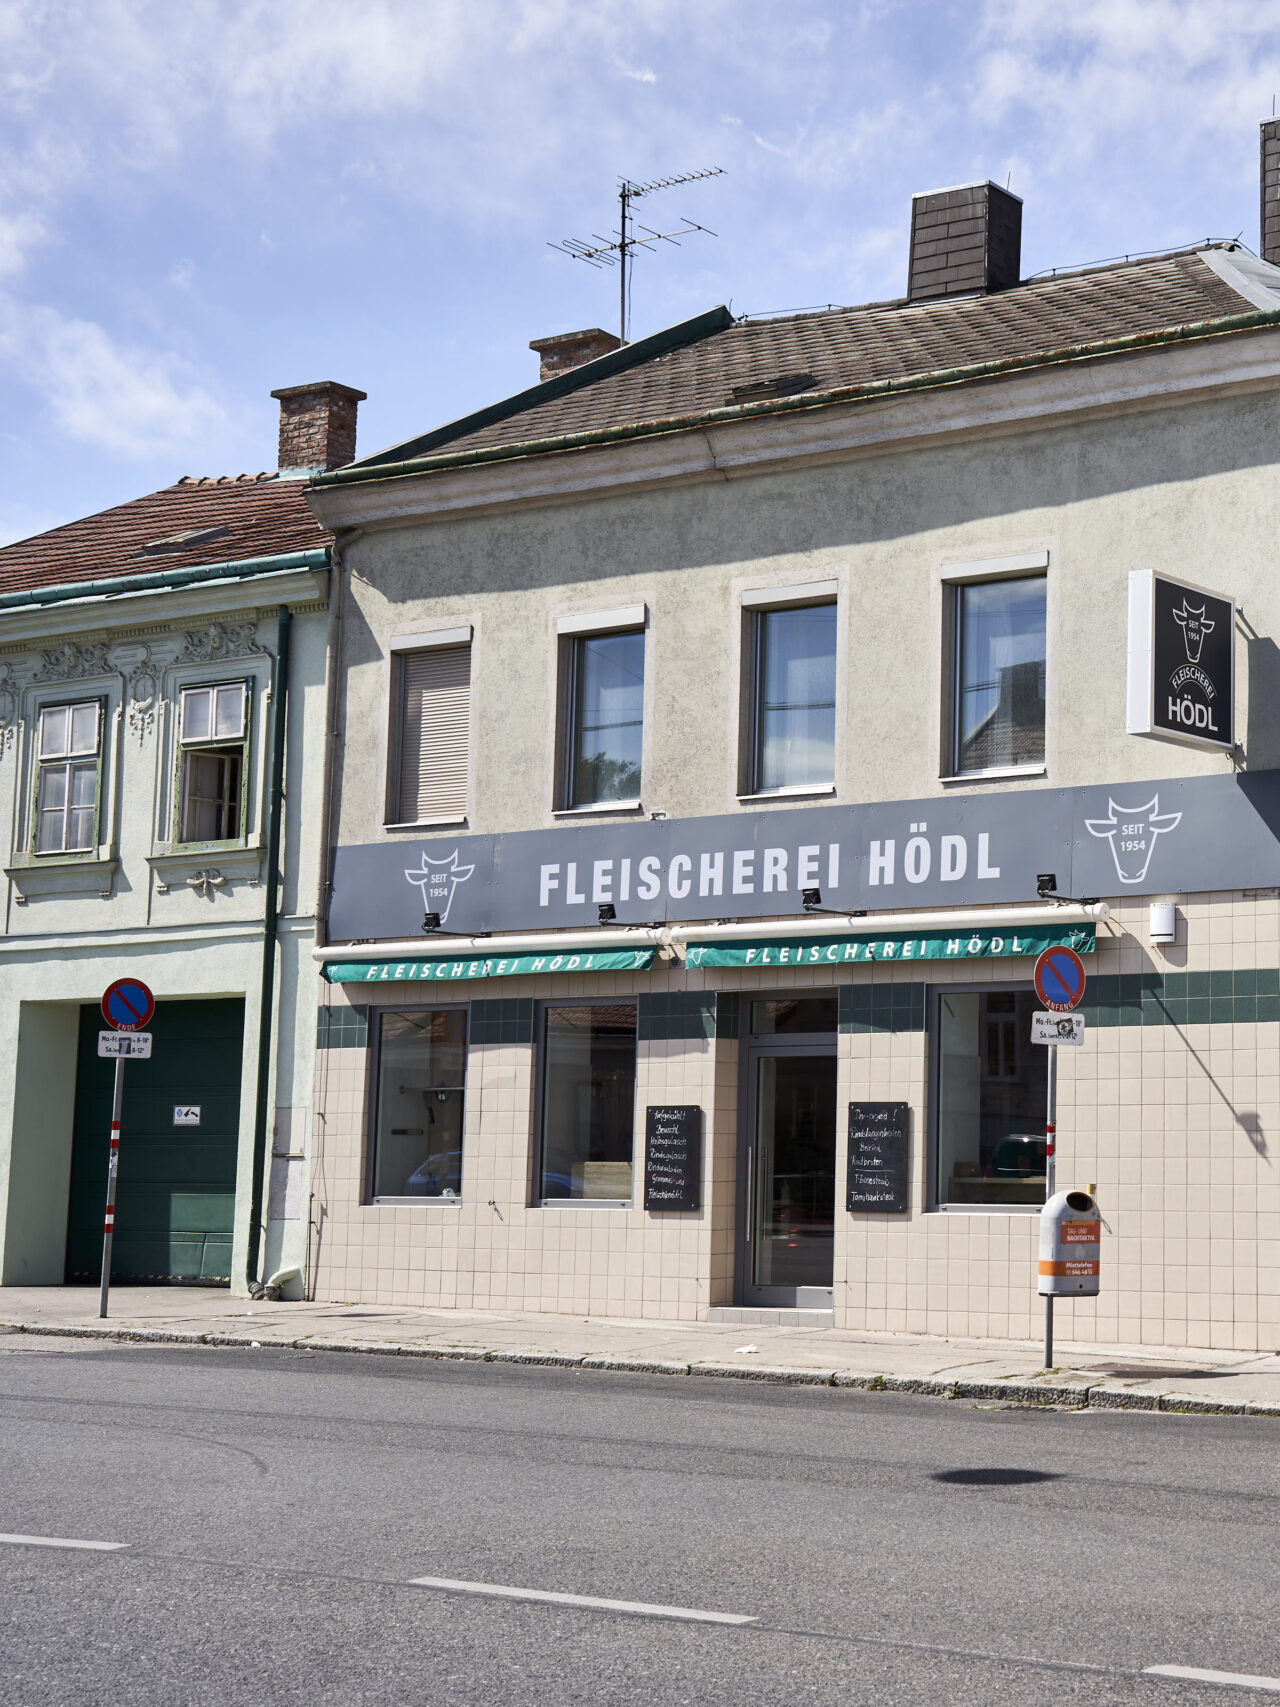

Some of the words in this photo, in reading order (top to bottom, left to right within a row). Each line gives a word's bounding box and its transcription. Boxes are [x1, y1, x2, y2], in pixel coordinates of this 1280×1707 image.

[1189, 620, 1199, 629] SEIT
[1188, 632, 1200, 641] 1954
[1172, 667, 1215, 700] FLEISCHEREI
[1168, 694, 1218, 732] HÖDL
[1122, 823, 1144, 836] SEIT
[1120, 840, 1146, 851] 1954
[540, 844, 840, 906] FLEISCHEREI
[869, 822, 1001, 886] HÖDL
[431, 874, 448, 883] SEIT
[429, 888, 448, 897] 1954
[745, 940, 927, 963] FLEISCHEREI
[947, 934, 1023, 955] HÖDL
[366, 960, 518, 979] FLEISCHEREI
[531, 955, 594, 971] HÖDL
[1045, 1000, 1074, 1011] ANFANG
